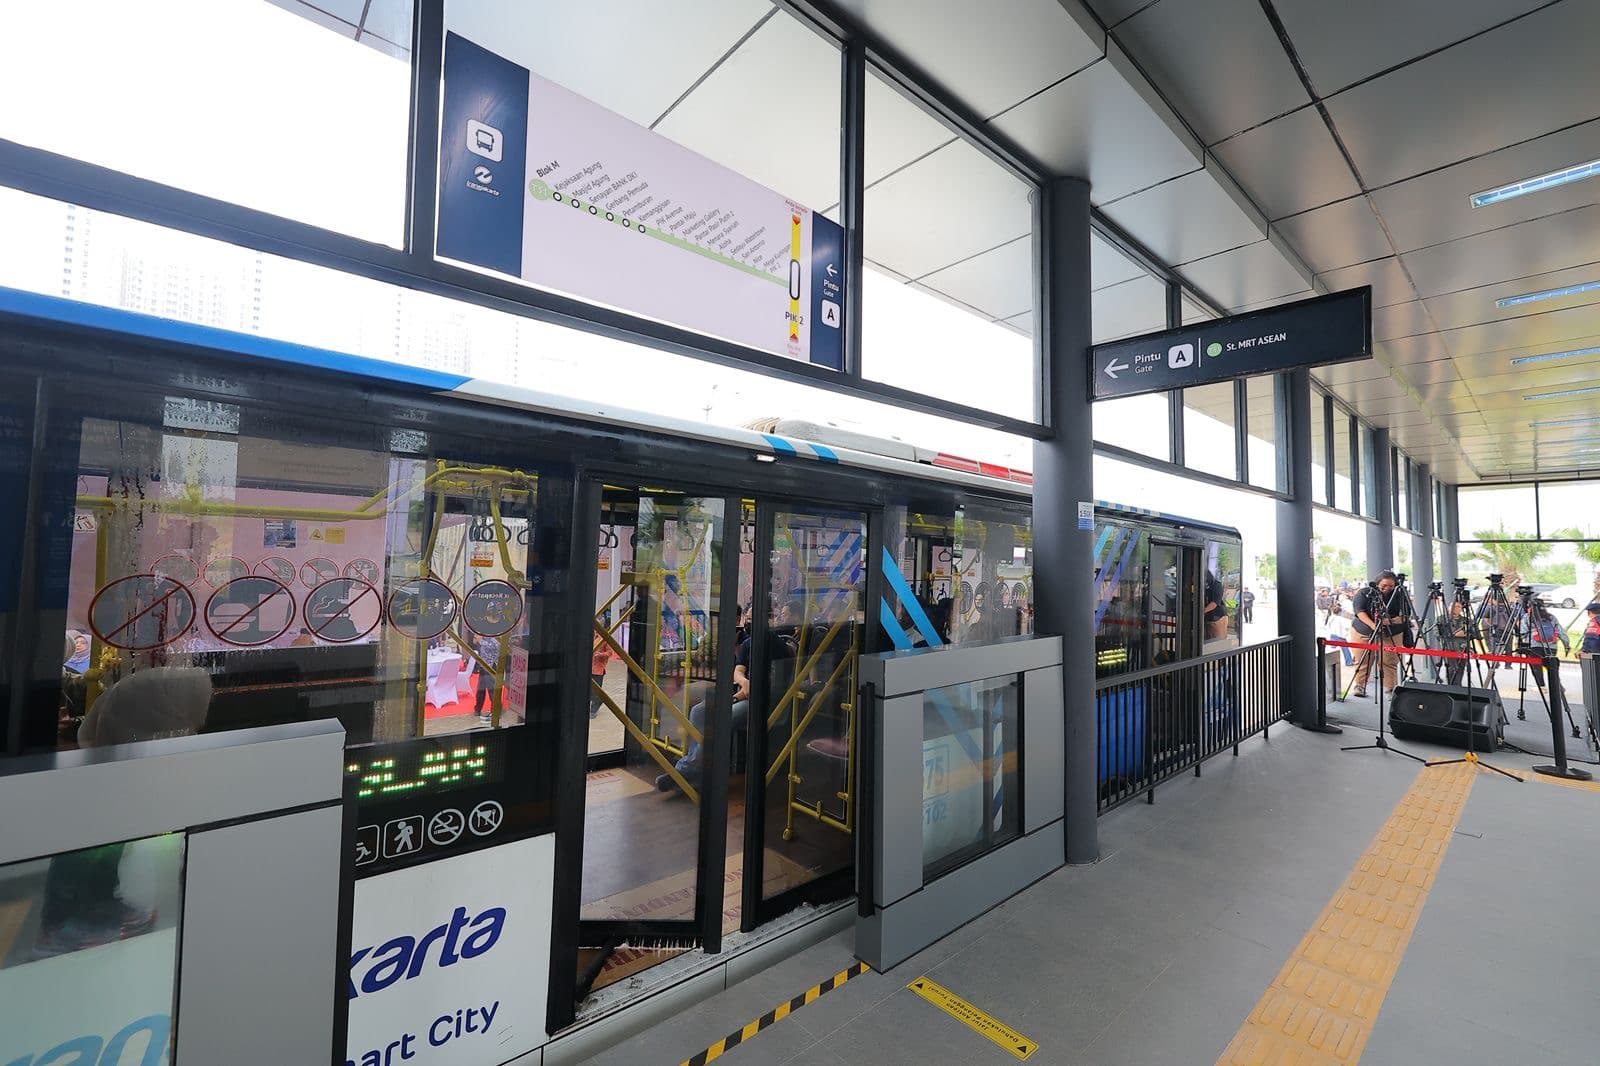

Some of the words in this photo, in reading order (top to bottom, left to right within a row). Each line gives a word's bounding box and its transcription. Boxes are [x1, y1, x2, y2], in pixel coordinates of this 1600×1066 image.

[536, 165, 553, 178] Blok
[551, 160, 560, 169] M
[554, 171, 584, 191] Kejaksaan
[583, 161, 602, 175] Agung
[572, 183, 592, 198] Masjid
[591, 174, 611, 188] Agung
[589, 187, 613, 204] Senayan
[611, 177, 628, 191] BANK
[626, 171, 638, 182] DKI
[605, 194, 630, 211] Gerbang
[628, 182, 649, 197] Pemuda
[823, 278, 839, 292] Pintu
[823, 288, 834, 298] Gate
[785, 311, 798, 323] PIK
[800, 316, 804, 325] 2
[827, 308, 835, 321] A
[1135, 352, 1161, 364] Pintu
[1175, 350, 1186, 363] A
[1238, 338, 1256, 349] MRT
[1258, 333, 1287, 346] ASEAN
[1135, 365, 1153, 374] Gate
[428, 1001, 499, 1047] City
[983, 1020, 1019, 1043] Dahulukan
